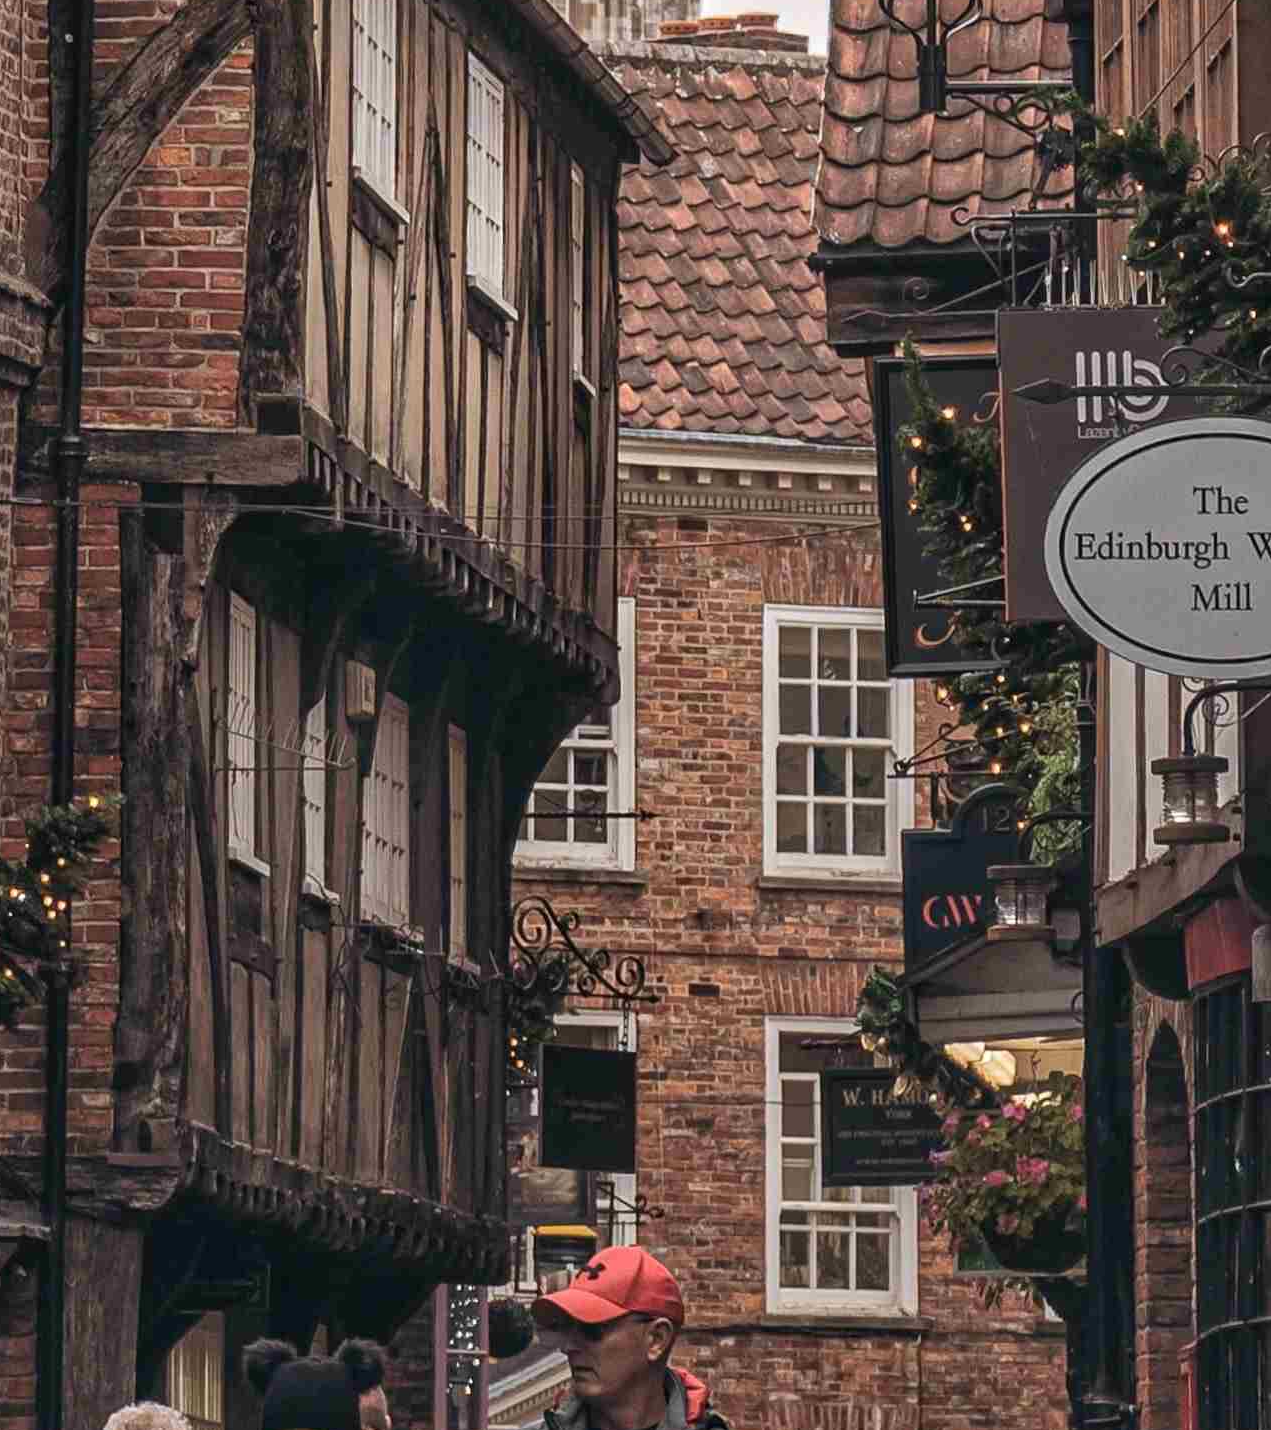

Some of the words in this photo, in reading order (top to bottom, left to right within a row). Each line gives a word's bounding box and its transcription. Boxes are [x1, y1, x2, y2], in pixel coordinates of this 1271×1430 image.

[1192, 486, 1250, 517] The
[1074, 532, 1231, 569] Edinburgh
[1191, 583, 1254, 612] Mill
[872, 1088, 929, 1106] HAMO
